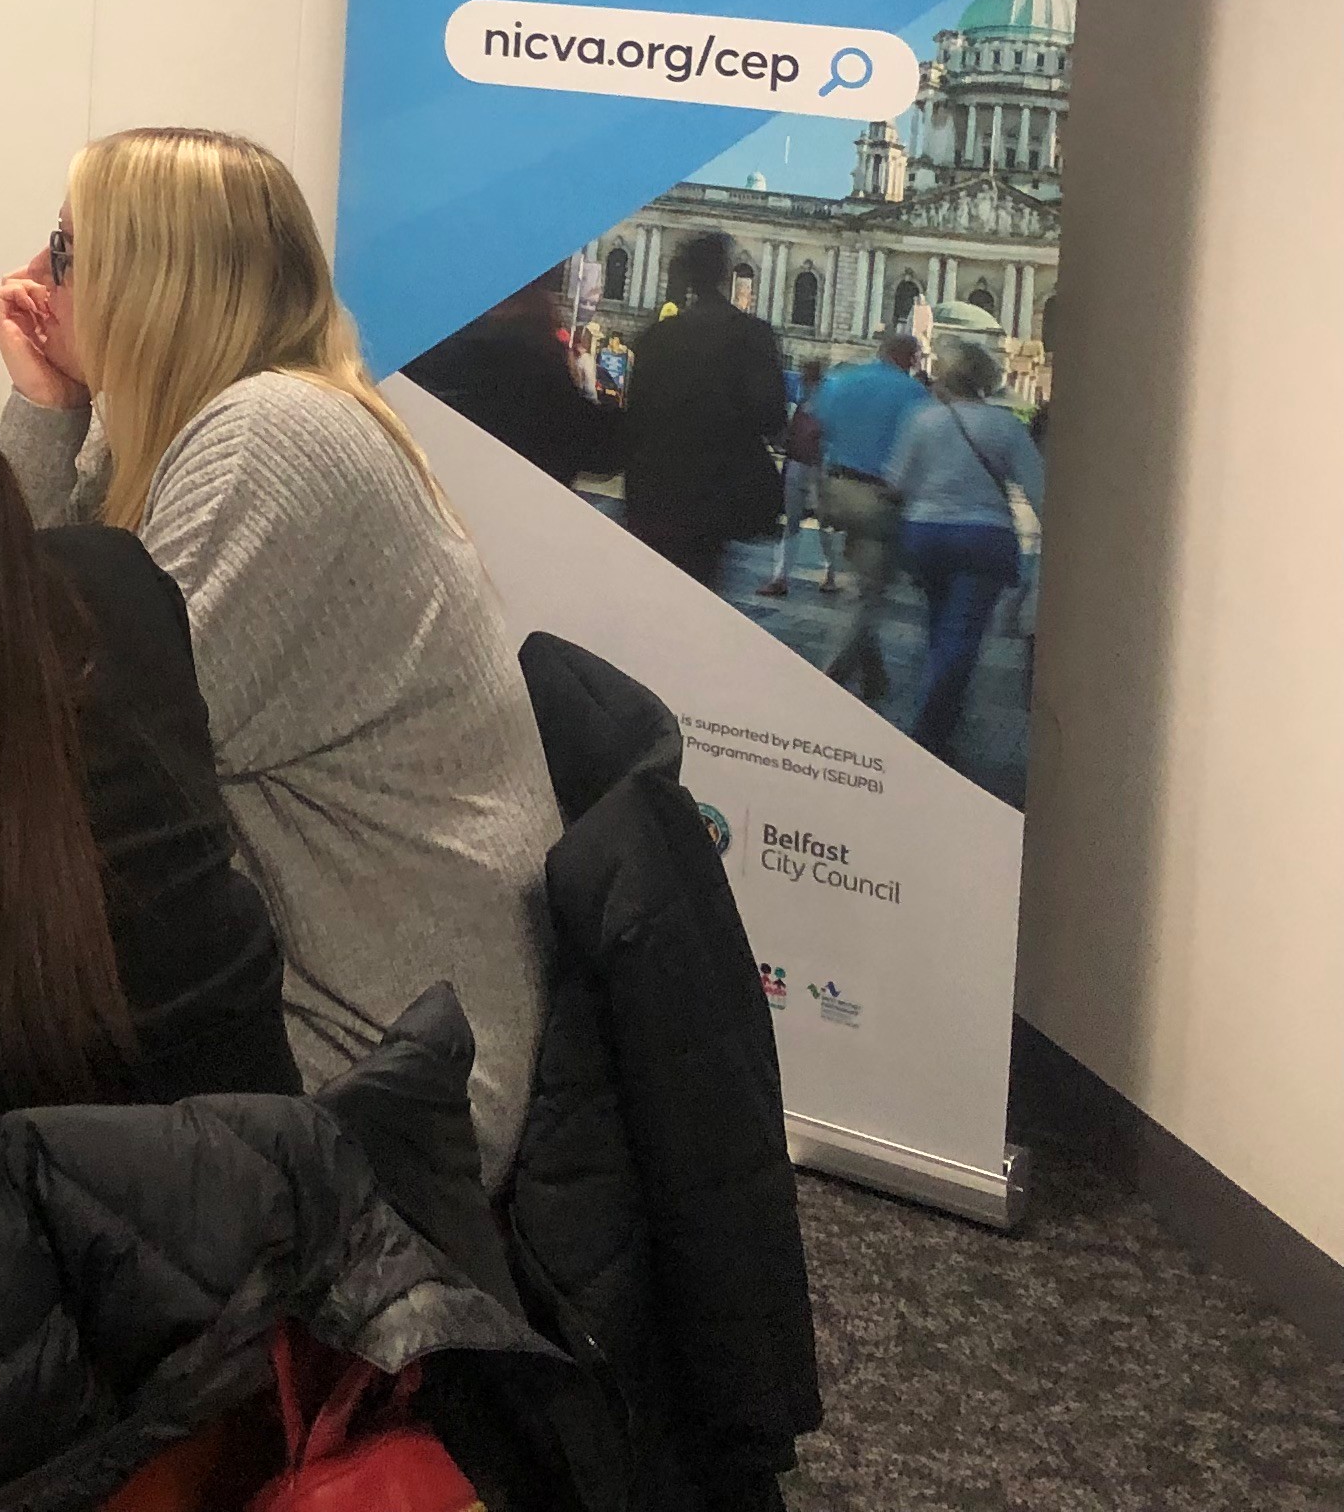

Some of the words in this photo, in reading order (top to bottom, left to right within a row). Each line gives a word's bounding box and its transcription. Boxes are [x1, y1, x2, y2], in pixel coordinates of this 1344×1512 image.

[484, 21, 800, 92] nicva.org/cep
[680, 713, 692, 727] is
[695, 718, 769, 745] supported
[772, 733, 790, 751] by
[792, 737, 886, 774] PEACEPLUS,
[686, 736, 779, 769] Programmes
[782, 758, 820, 781] Body
[823, 768, 884, 795] (SEUPB)
[763, 823, 851, 865] Belfast
[761, 848, 806, 883] City
[812, 861, 902, 905] Council
